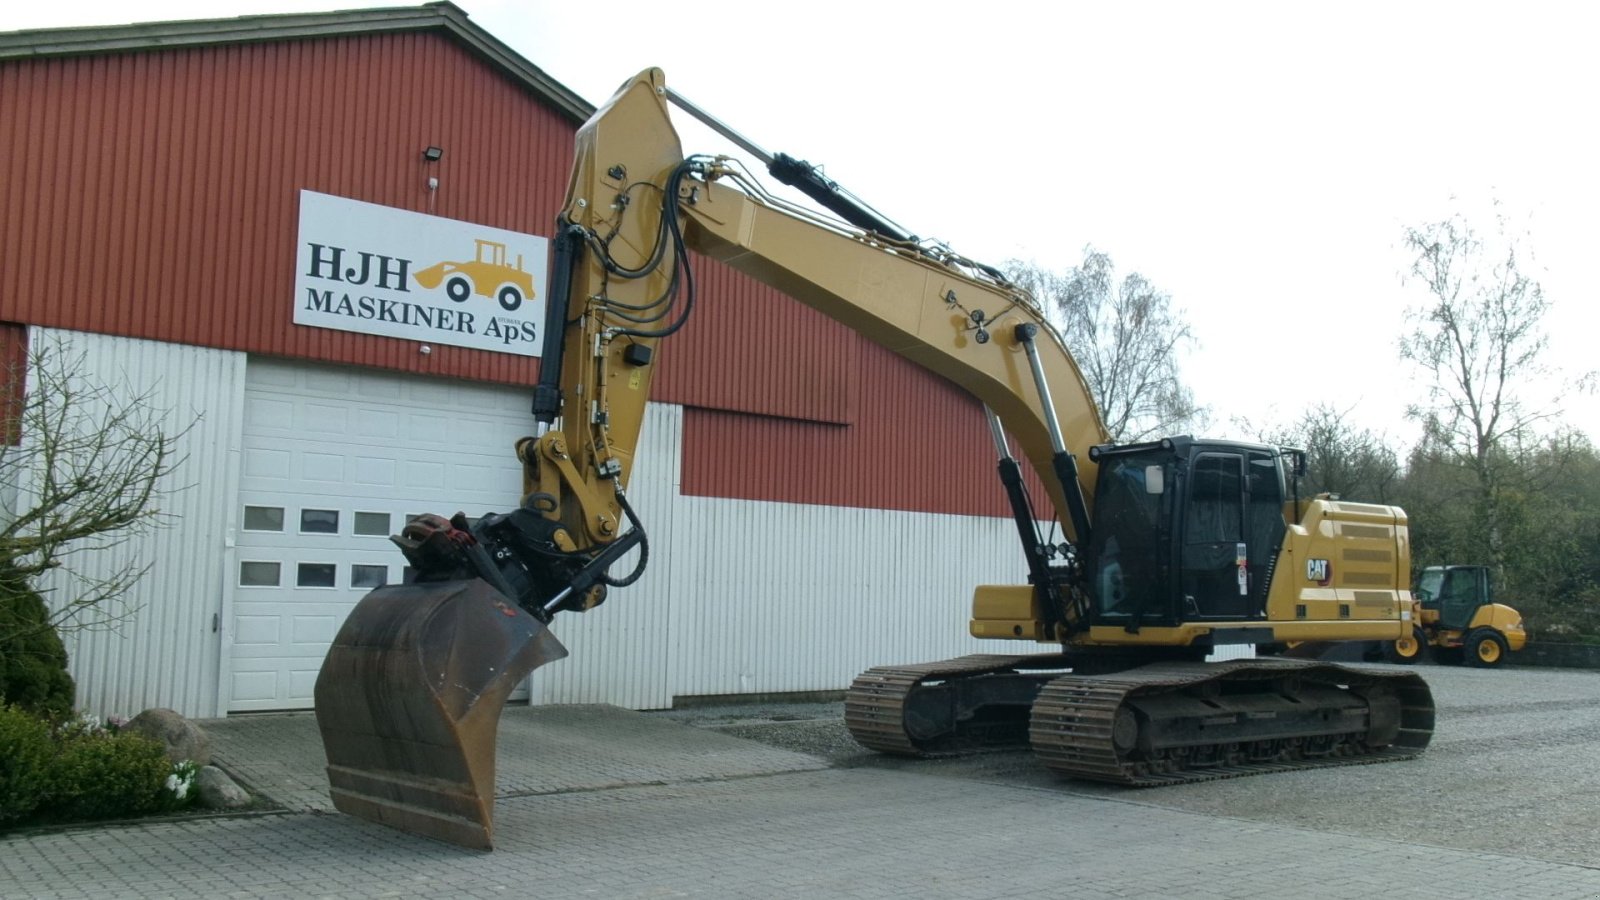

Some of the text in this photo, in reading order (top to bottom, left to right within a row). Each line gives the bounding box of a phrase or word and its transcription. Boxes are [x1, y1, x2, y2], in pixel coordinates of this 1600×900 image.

[306, 242, 413, 292] HJH
[304, 287, 536, 344] MASKINER ApS
[1307, 559, 1328, 580] CAT
